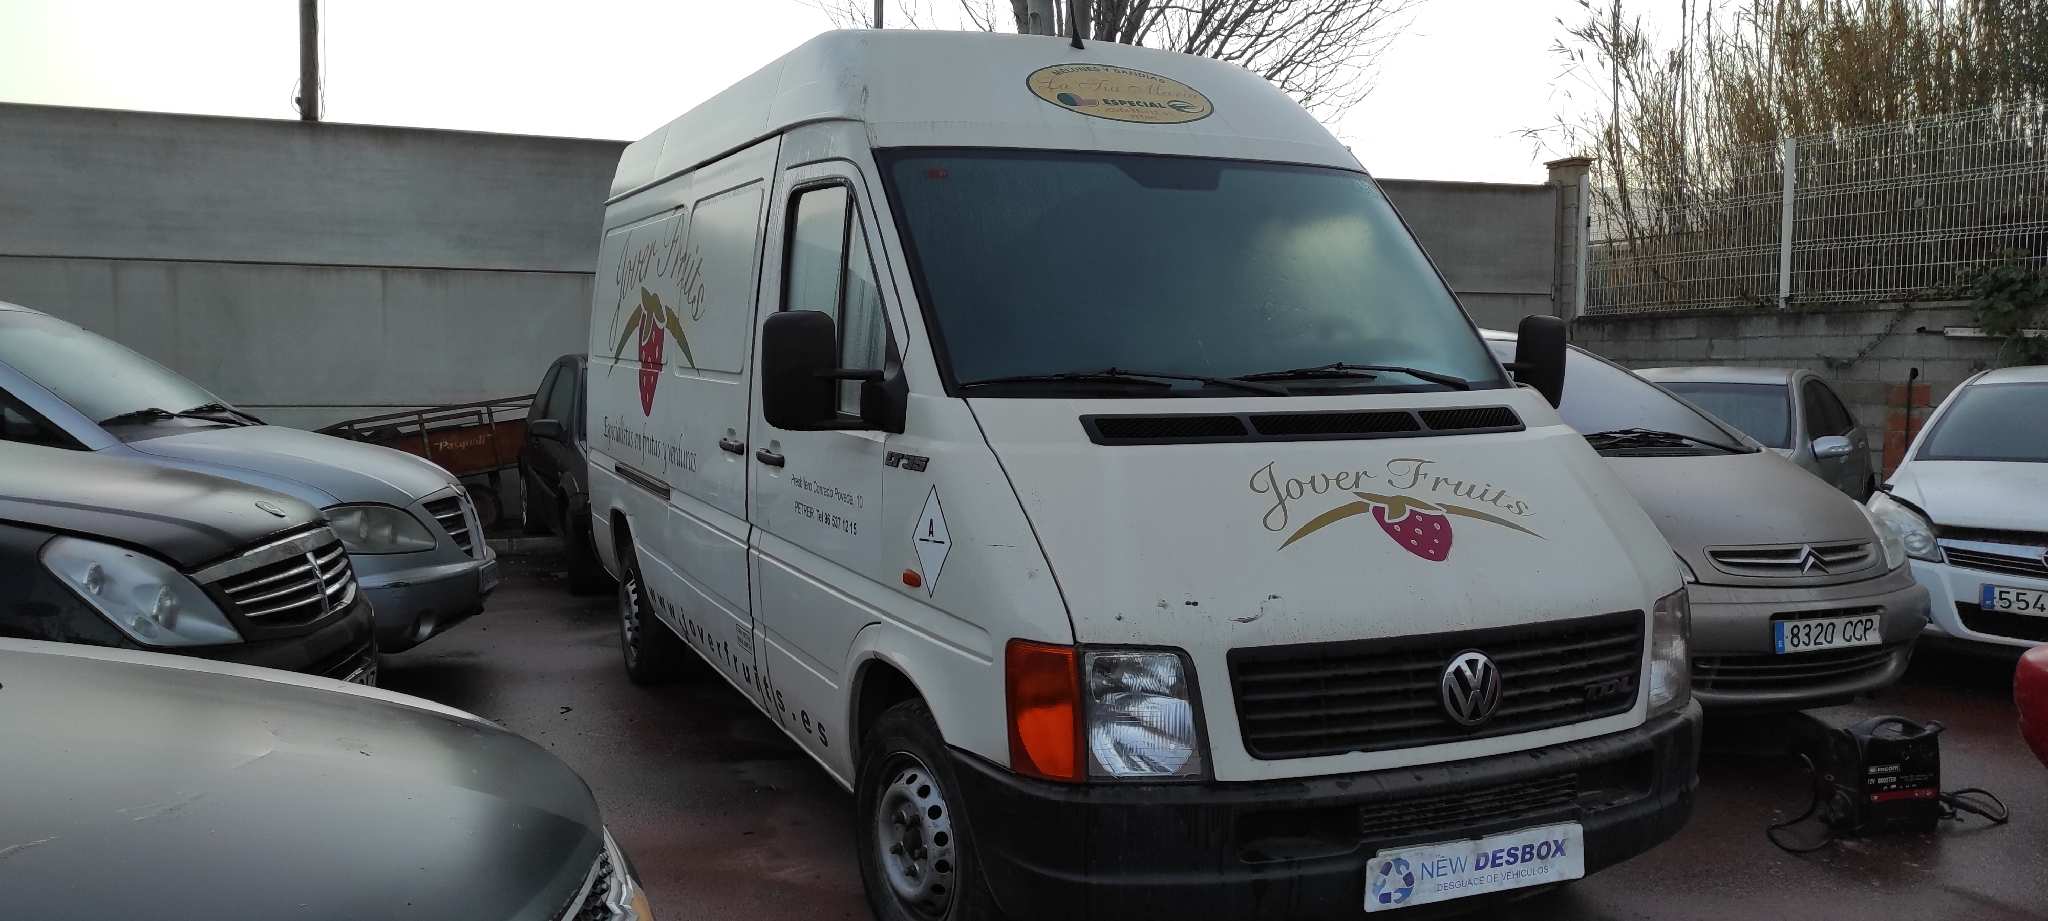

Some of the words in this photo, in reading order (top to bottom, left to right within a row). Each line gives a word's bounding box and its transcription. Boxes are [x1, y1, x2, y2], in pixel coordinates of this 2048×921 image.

[1102, 98, 1166, 109] ESPECIAL
[609, 229, 658, 352] Jover
[657, 212, 706, 322] Fruits
[641, 422, 661, 466] frutas
[669, 432, 697, 473] verduras
[1250, 461, 1377, 531] Jover
[1387, 458, 1537, 517] Fruits
[928, 518, 935, 537] A
[1998, 590, 2047, 613] 554
[1790, 622, 1836, 648] 8320
[1843, 618, 1874, 643] CCP
[1420, 854, 1468, 881] NEW
[1474, 839, 1568, 871] DESBOX
[1437, 876, 1485, 892] DESGUACE
[1485, 873, 1500, 885] DE
[1500, 865, 1551, 882] VEHICULOS
